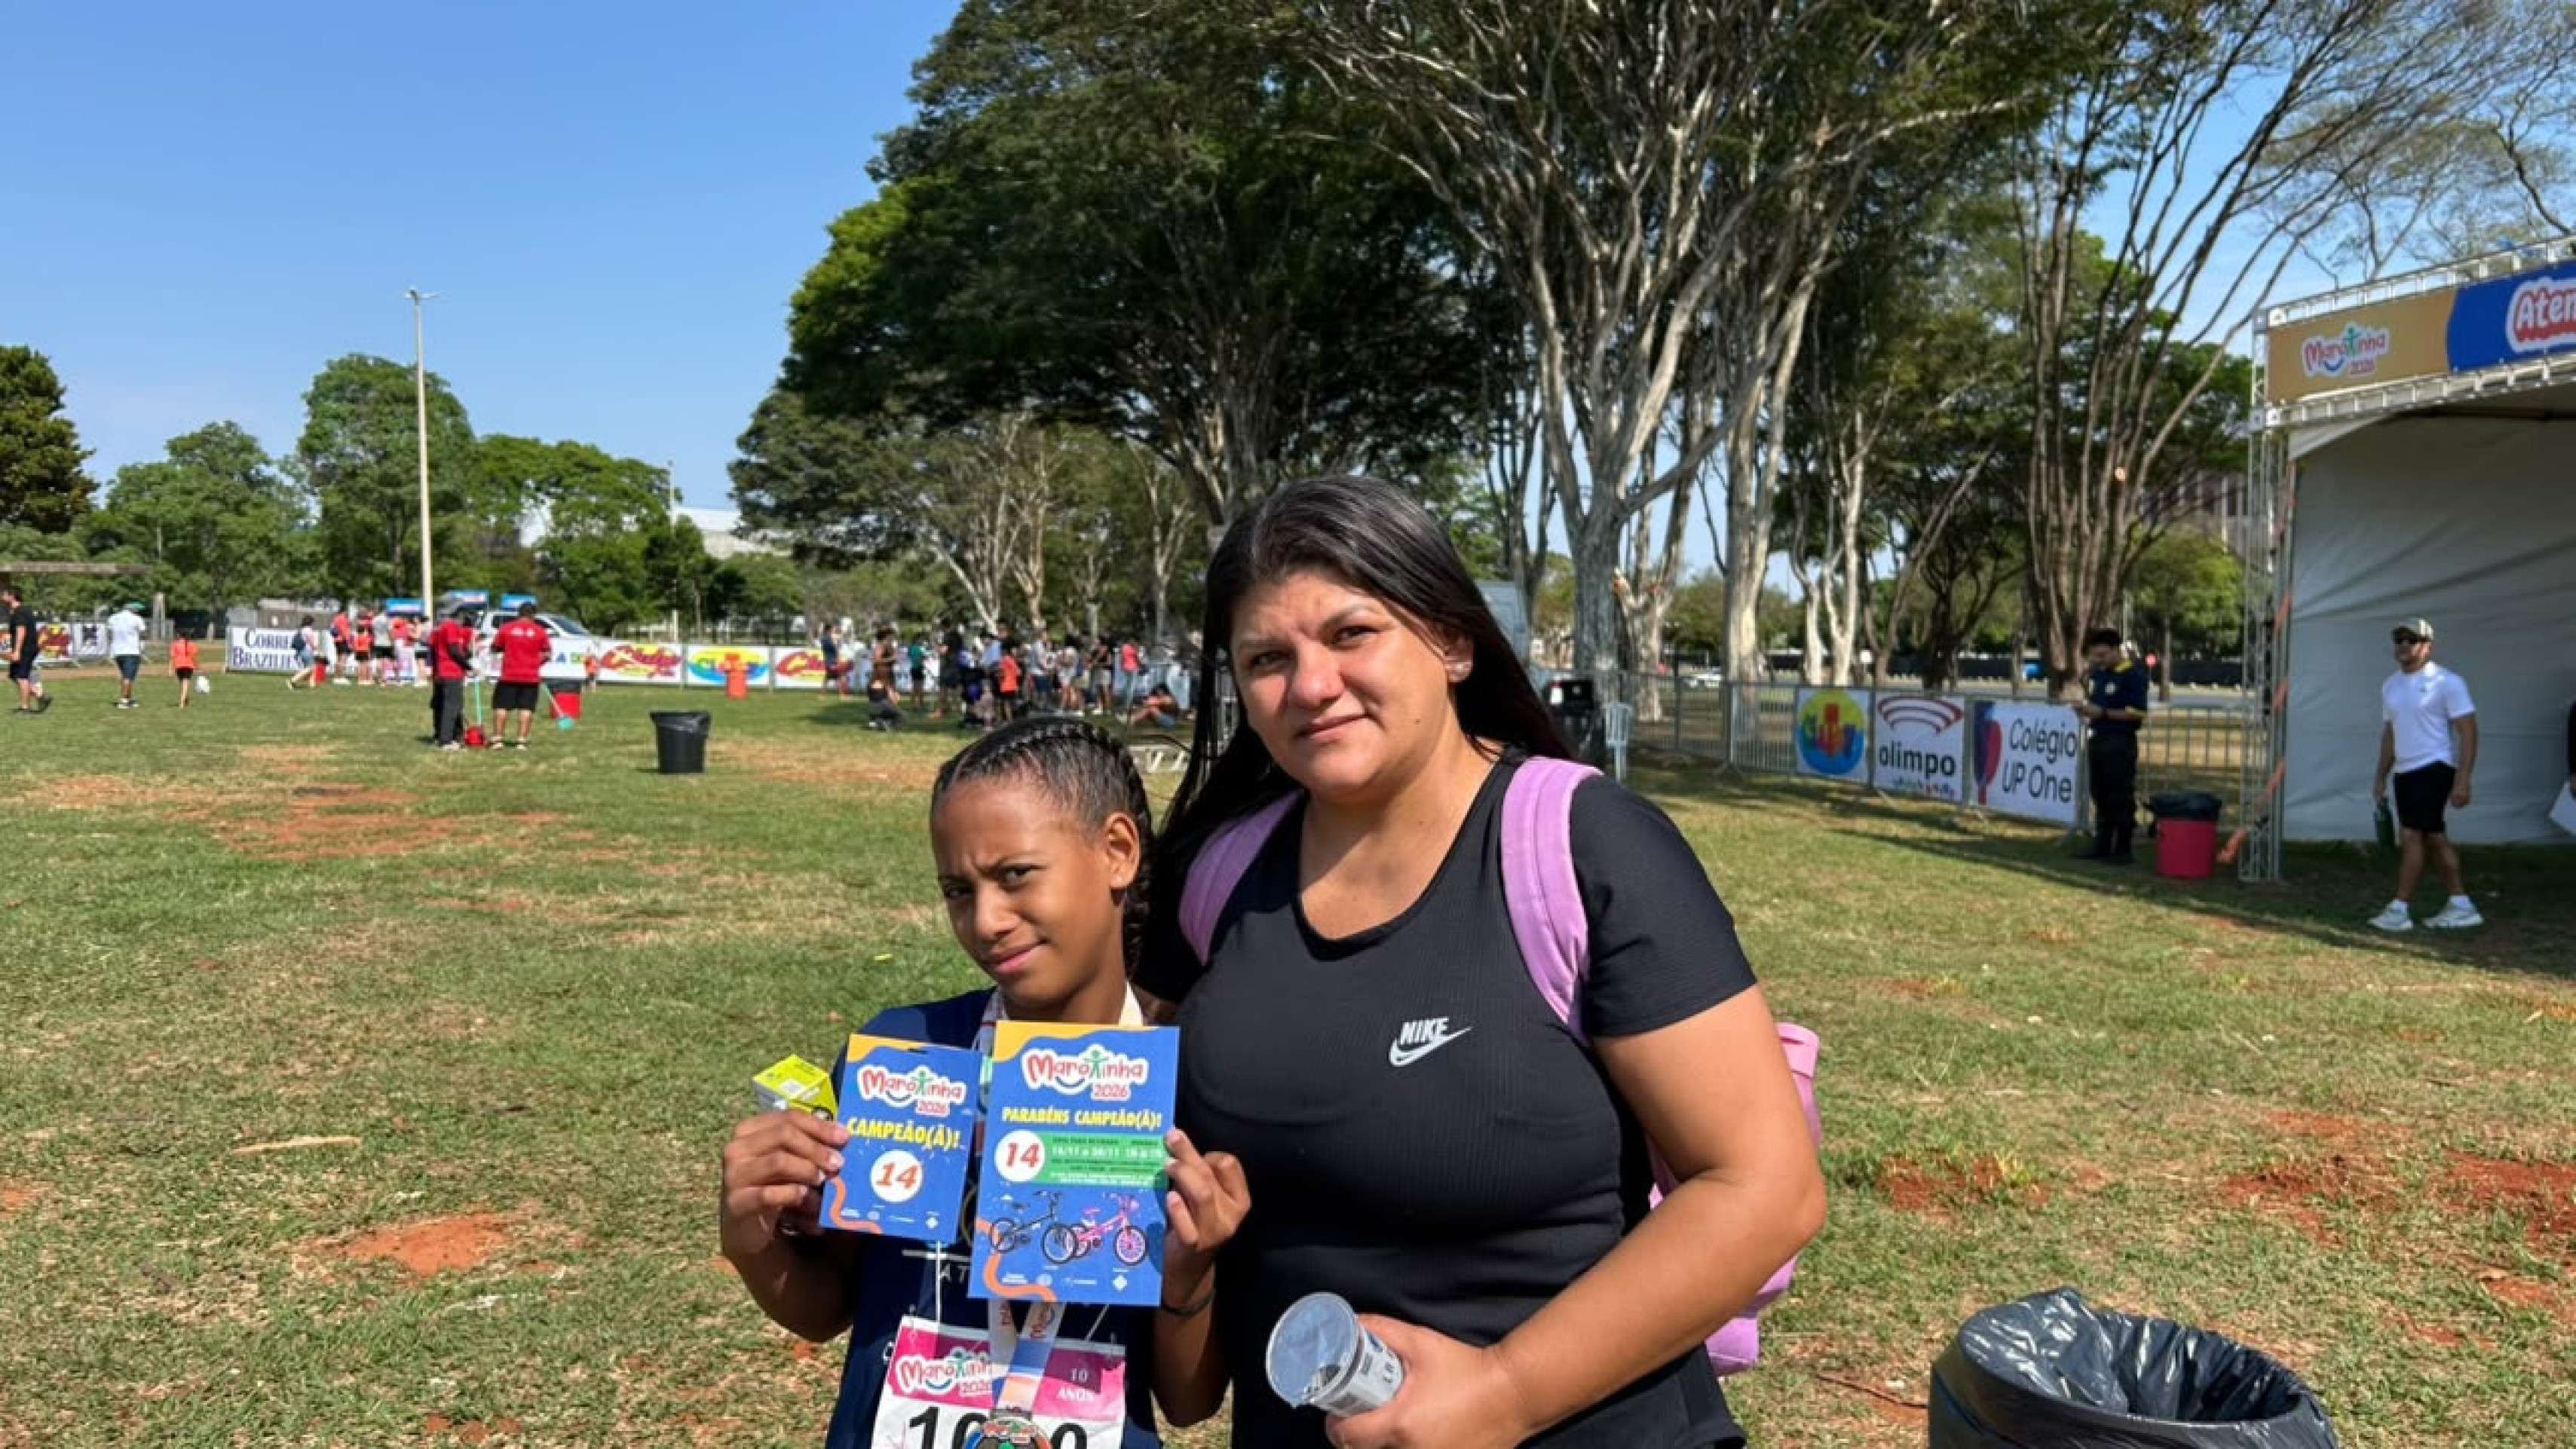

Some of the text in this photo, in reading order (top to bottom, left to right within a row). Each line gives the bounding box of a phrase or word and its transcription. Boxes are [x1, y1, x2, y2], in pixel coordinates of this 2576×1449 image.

[244, 629, 290, 649] CORRE
[2010, 718, 2077, 764] Colégio
[1879, 740, 1956, 780] olimpo
[2002, 758, 2072, 804] UP One
[1400, 1016, 1449, 1045] NIKE
[1006, 1141, 1040, 1169] 14
[874, 1163, 920, 1190] 14
[900, 1351, 993, 1389] Marotinh
[1071, 1367, 1089, 1383] 10
